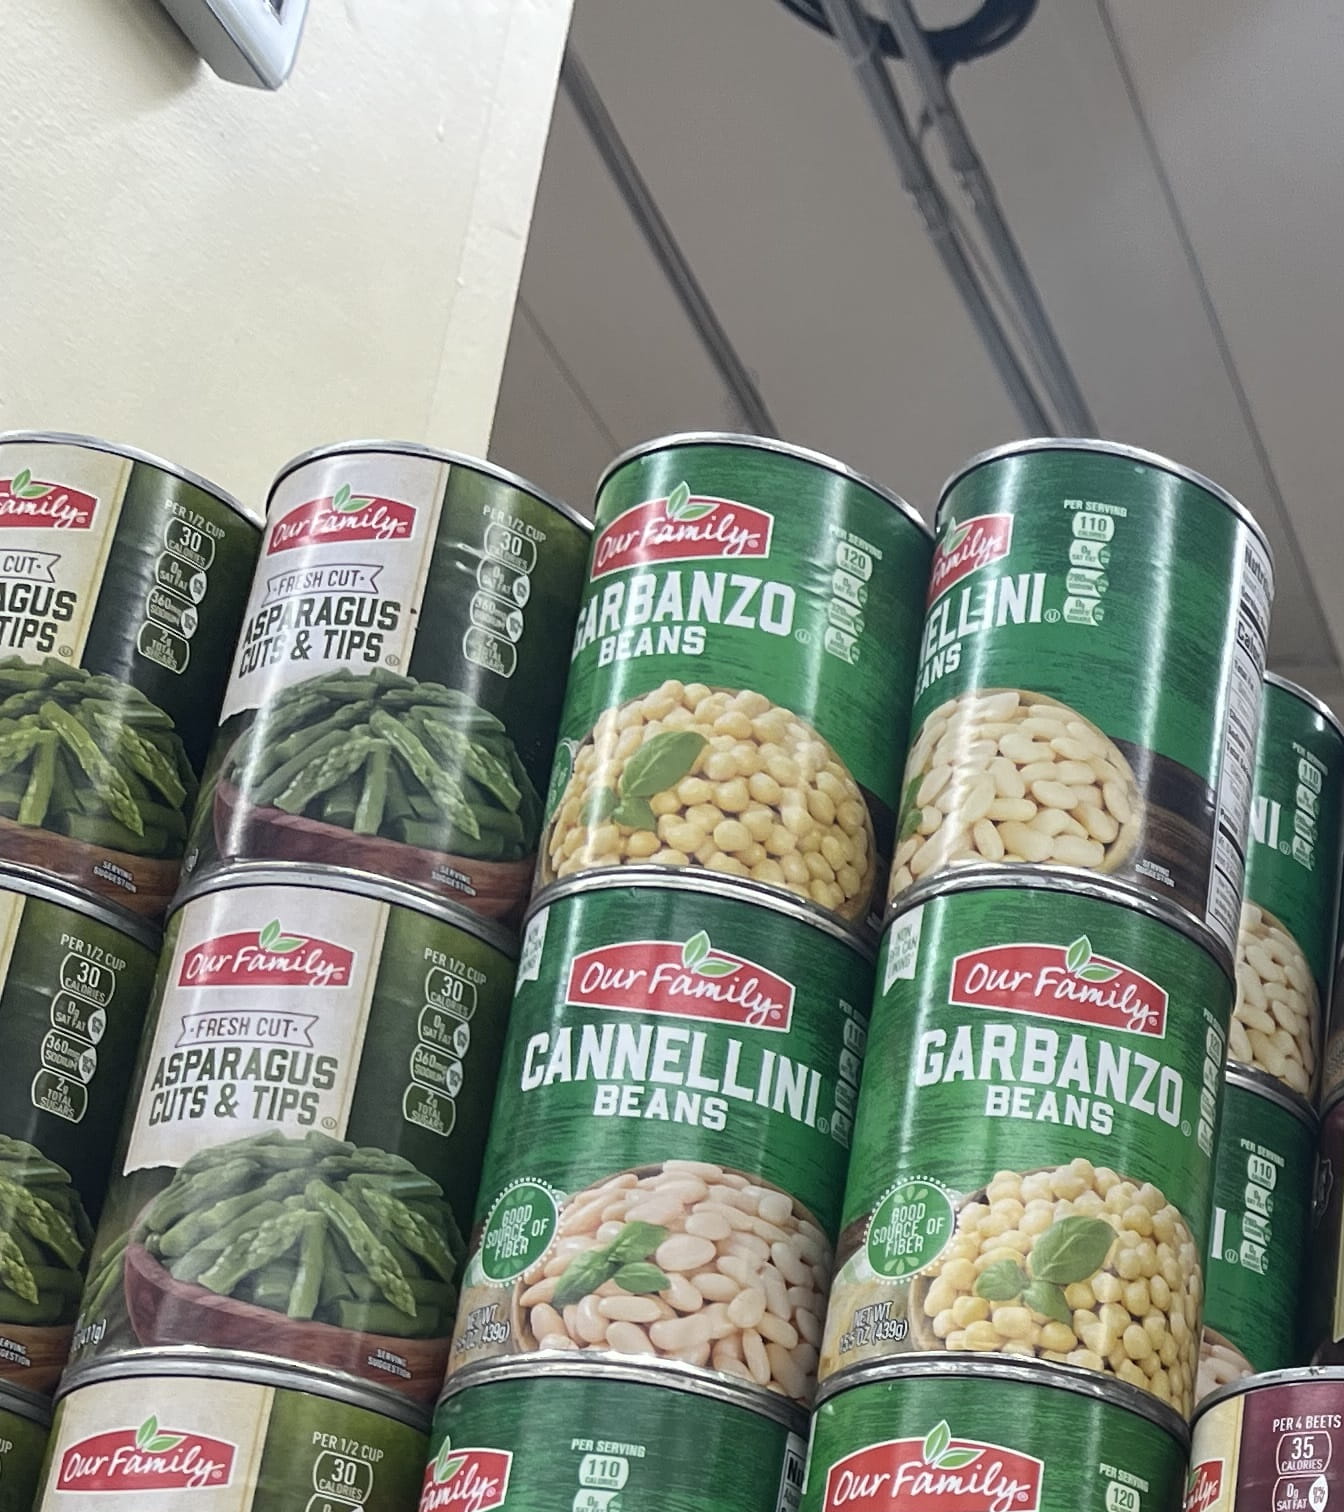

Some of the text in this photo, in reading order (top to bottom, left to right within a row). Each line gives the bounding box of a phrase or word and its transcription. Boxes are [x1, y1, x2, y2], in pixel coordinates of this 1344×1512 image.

[597, 626, 706, 668] BEANS
[60, 933, 126, 972] PER 1/2 CUP
[75, 962, 101, 988] 30
[186, 947, 343, 985] Our Family
[197, 1018, 292, 1036] FRESH CUT
[151, 1049, 338, 1091] ASPARAGUS
[521, 1024, 822, 1127] CANNELLINI
[915, 1025, 1184, 1127] GARBANZO
[149, 1084, 320, 1126] CUTS & TIPS
[593, 1085, 729, 1132] BEANS
[892, 1203, 926, 1224] GOOD
[927, 1218, 945, 1235] OF
[885, 1236, 924, 1255] FIBER
[1273, 1415, 1341, 1431] PER BEETS
[571, 1439, 645, 1457] PER SERVING
[1291, 1438, 1314, 1458] 35
[587, 1459, 620, 1478] 110
[318, 1480, 363, 1500] CALORIES
